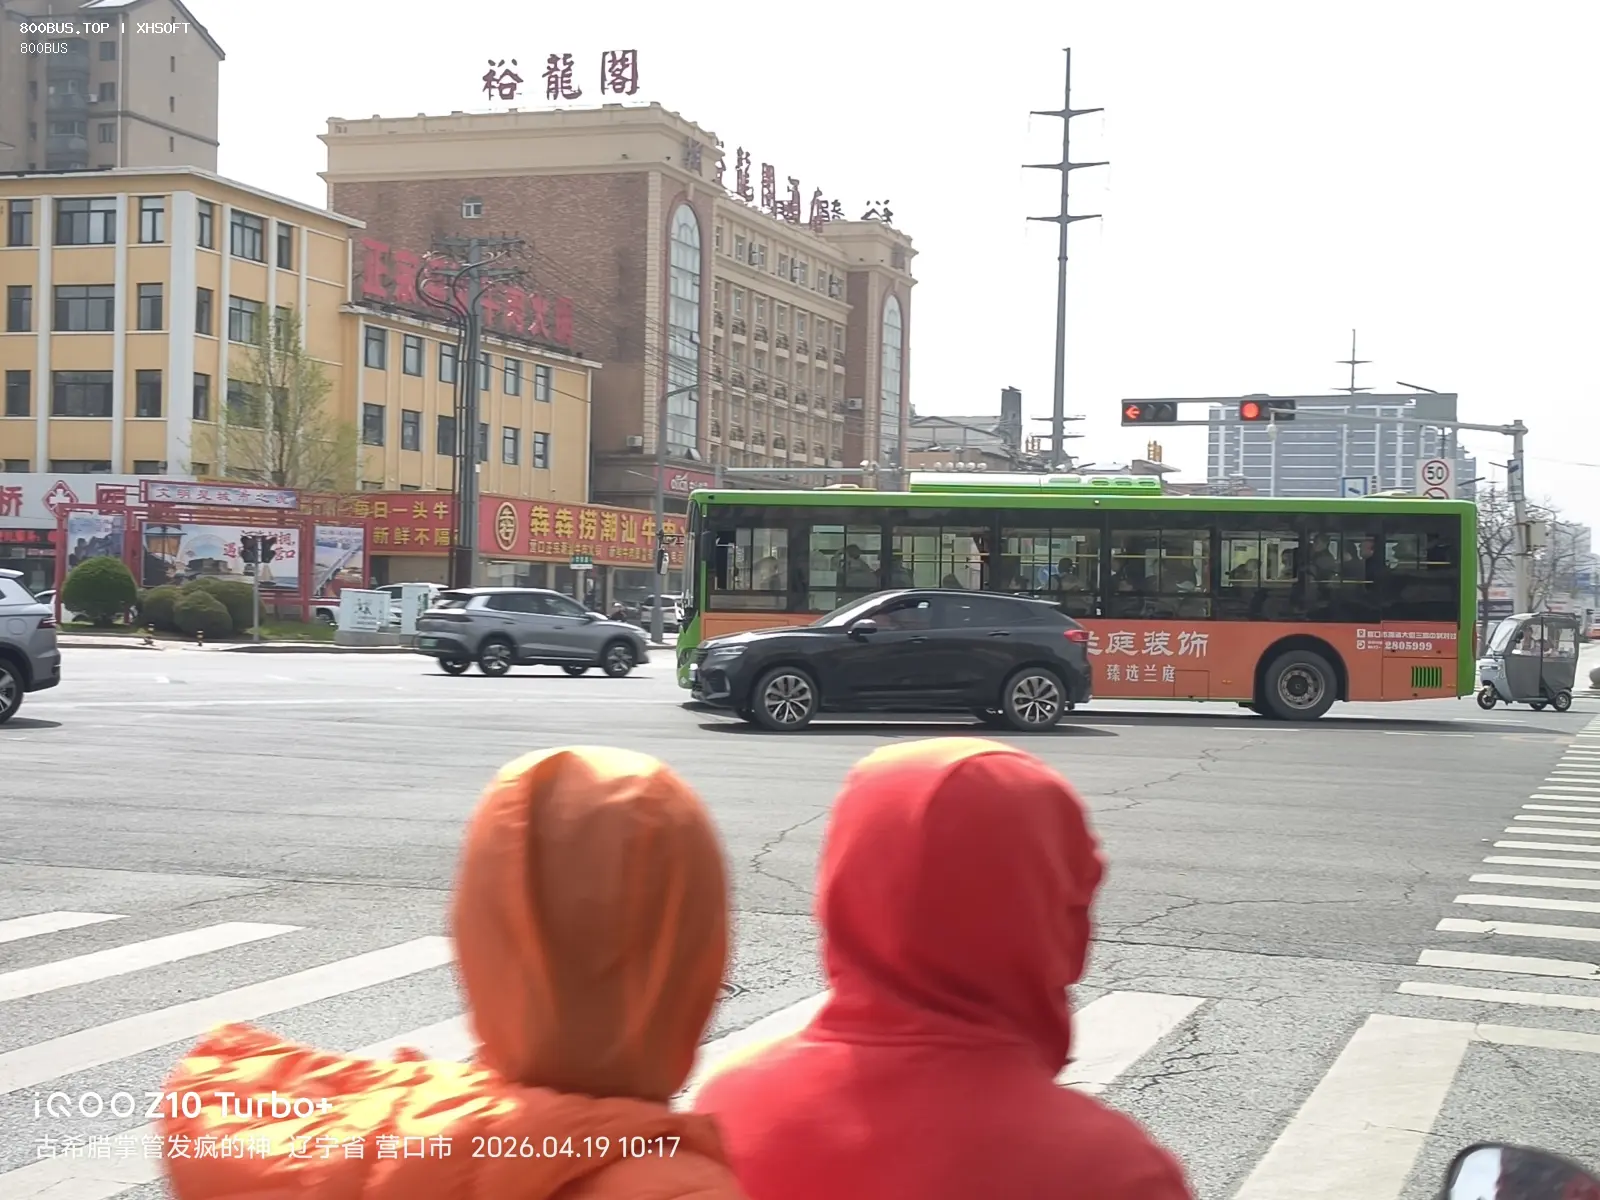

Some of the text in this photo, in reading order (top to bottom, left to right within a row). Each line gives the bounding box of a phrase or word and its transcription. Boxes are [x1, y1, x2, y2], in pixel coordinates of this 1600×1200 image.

[482, 49, 639, 101] 裕龍閣
[1427, 466, 1444, 480] 50
[373, 526, 459, 546] 新鲜不隔
[1384, 640, 1433, 651] 2805999
[1107, 663, 1176, 683] 臻选兰庭
